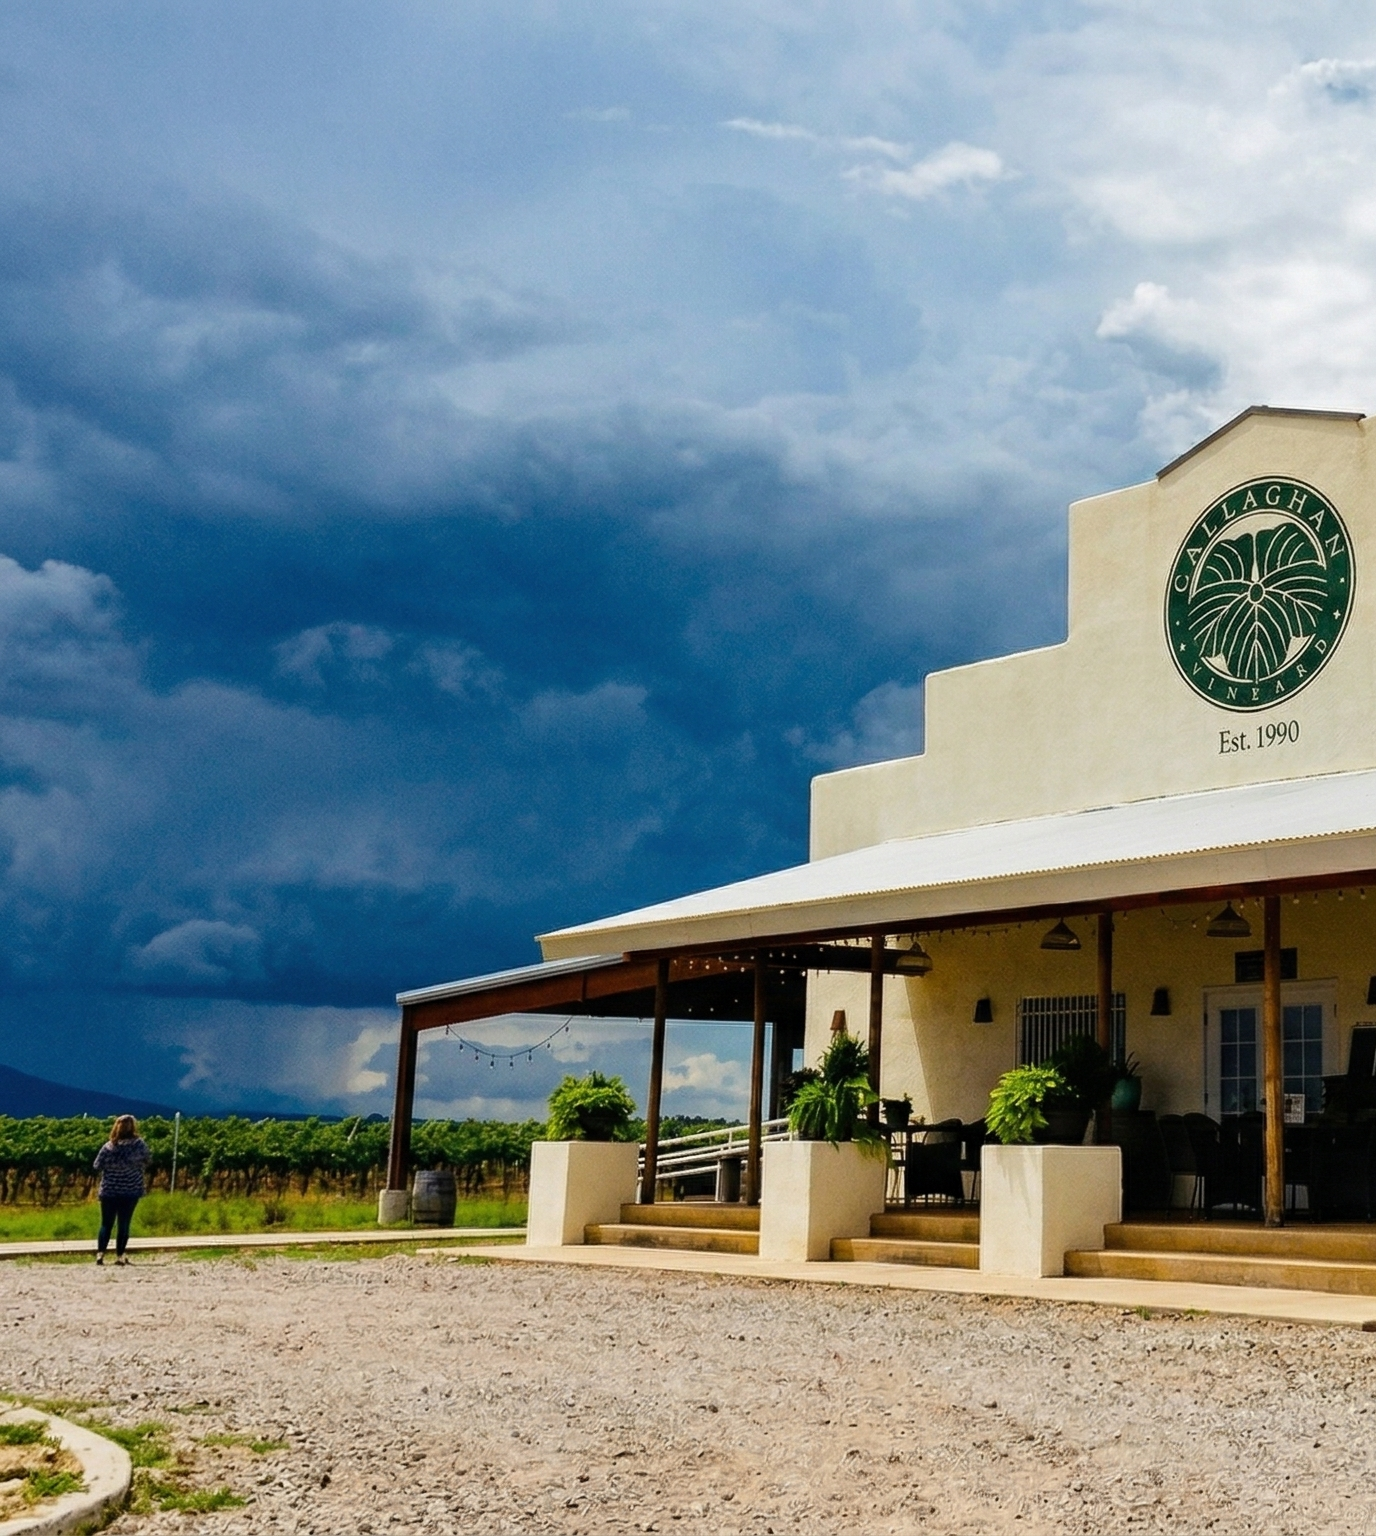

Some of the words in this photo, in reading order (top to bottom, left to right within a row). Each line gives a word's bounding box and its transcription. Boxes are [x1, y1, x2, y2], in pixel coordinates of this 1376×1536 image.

[1174, 486, 1345, 593] CALLAGHAN
[1193, 640, 1327, 701] VINEARD
[1219, 730, 1251, 754] Est.
[1257, 719, 1300, 748] 1990
